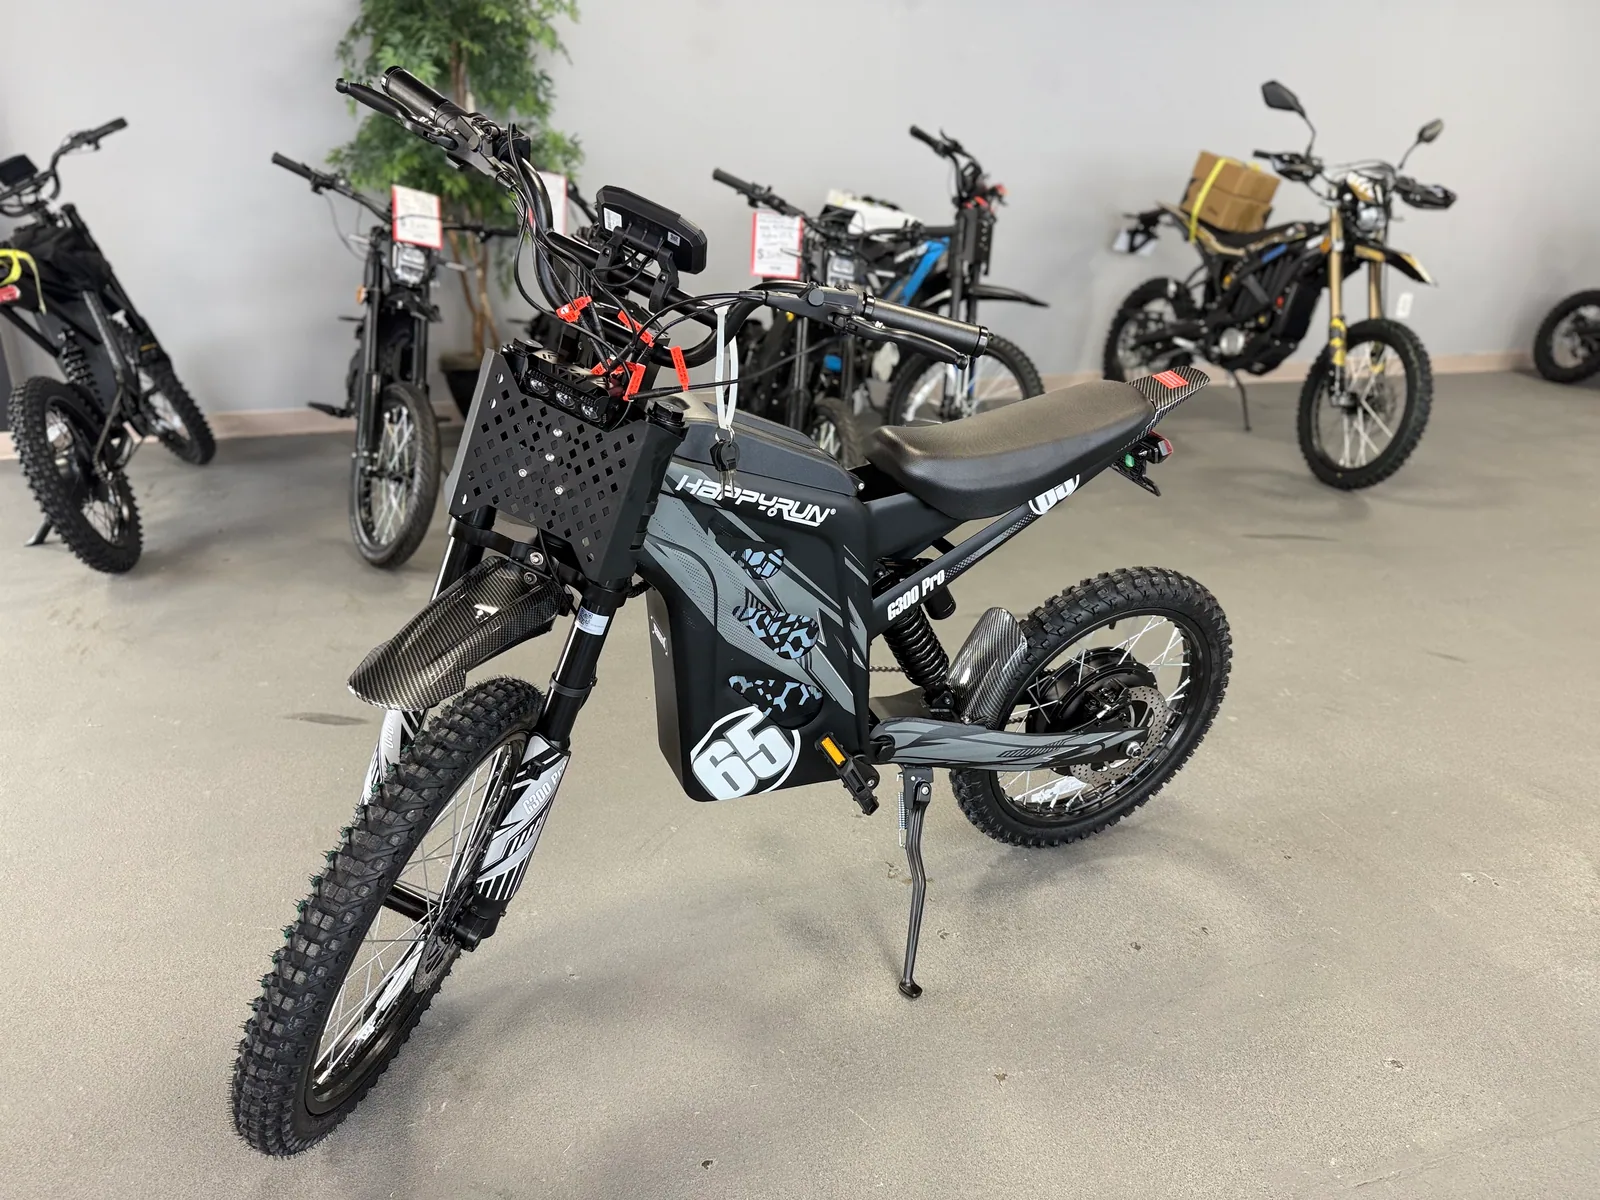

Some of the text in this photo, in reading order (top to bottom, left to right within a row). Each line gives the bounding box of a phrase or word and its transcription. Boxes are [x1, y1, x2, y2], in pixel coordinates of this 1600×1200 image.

[887, 569, 945, 621] G300 Pro
[692, 705, 794, 801] 65
[522, 781, 552, 815] G300
